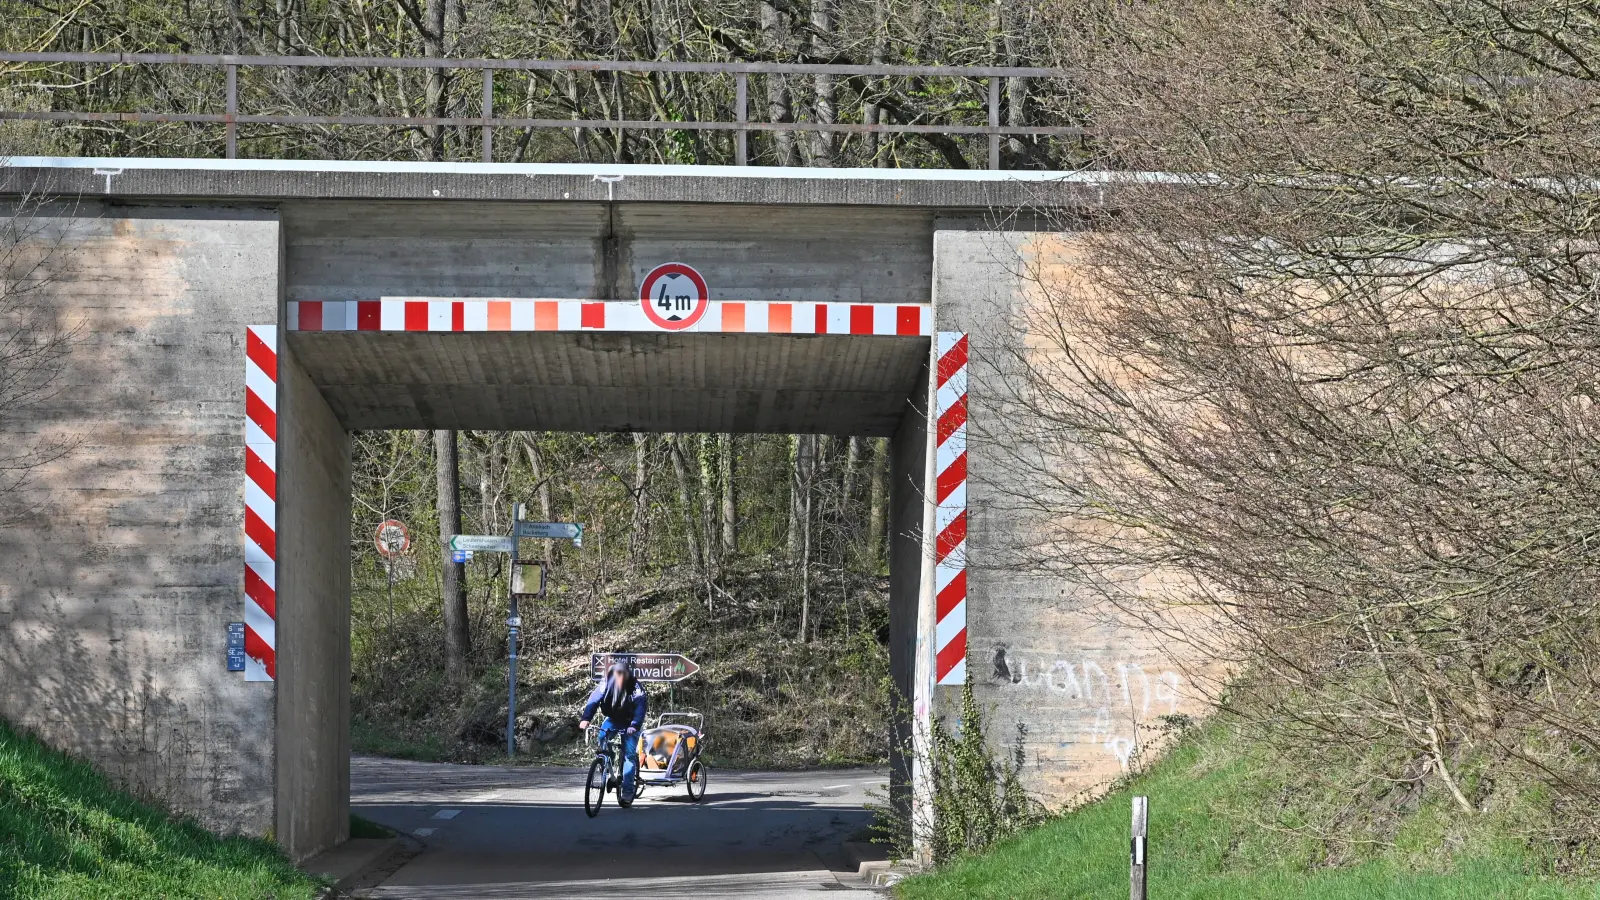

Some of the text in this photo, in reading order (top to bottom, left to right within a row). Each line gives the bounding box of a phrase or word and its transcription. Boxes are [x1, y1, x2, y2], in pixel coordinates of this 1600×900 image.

[608, 656, 672, 665] Hotel Restaurant
[629, 665, 672, 678] nwald
